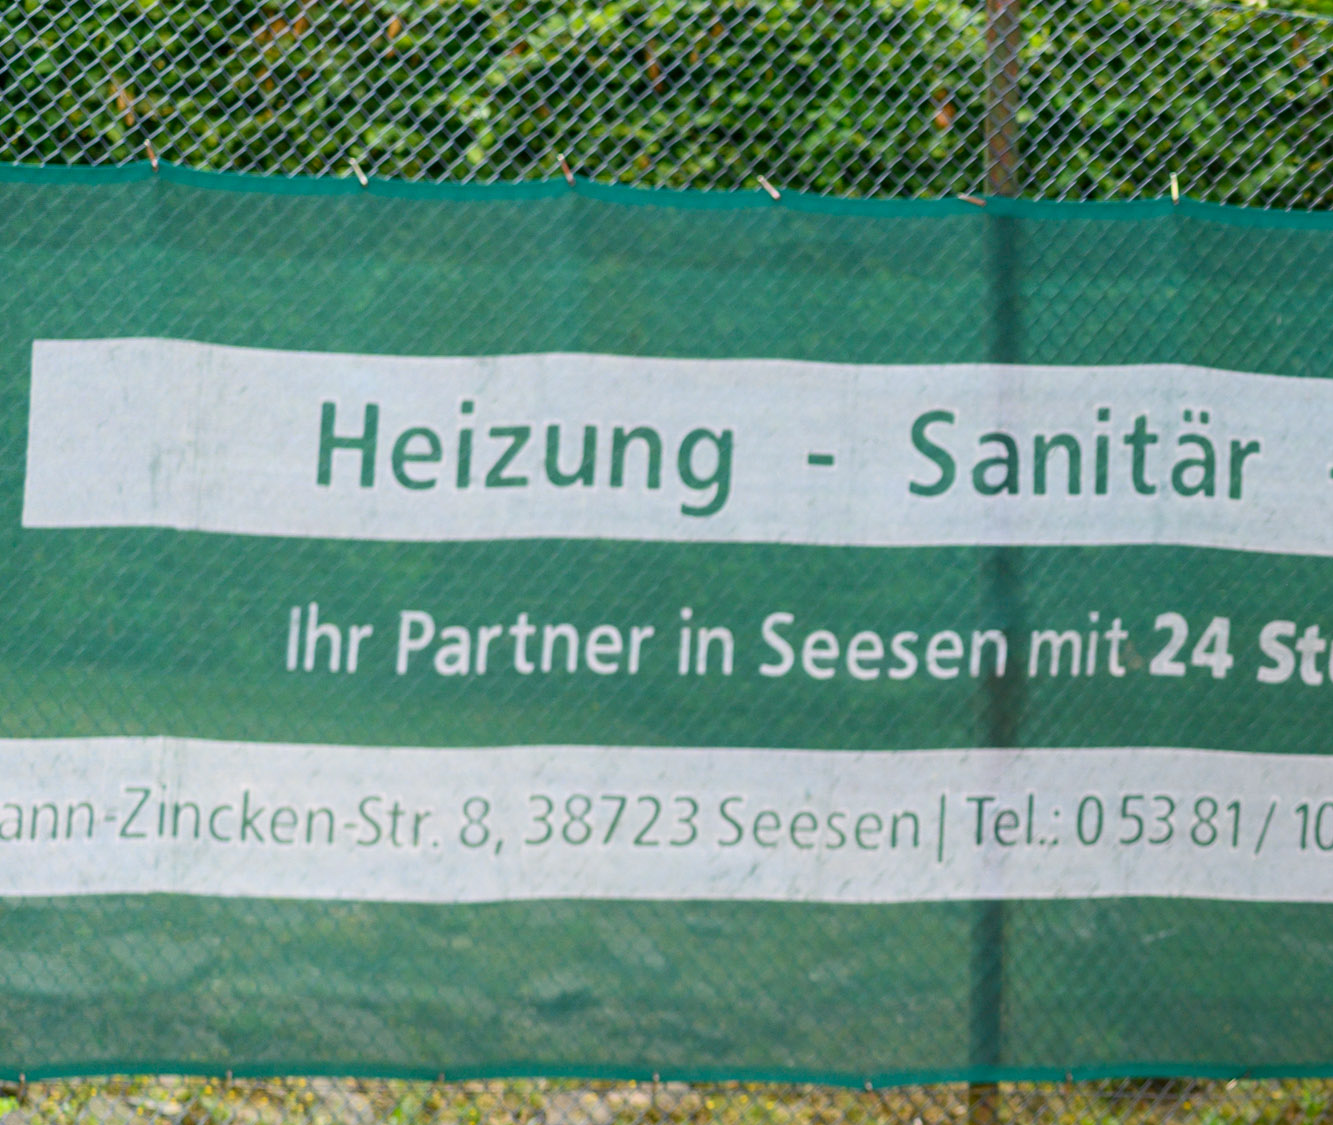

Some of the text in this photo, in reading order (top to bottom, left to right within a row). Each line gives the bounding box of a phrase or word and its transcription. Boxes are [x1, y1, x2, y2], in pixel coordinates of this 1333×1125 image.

[316, 401, 734, 518] Heizung
[908, 408, 1261, 500] Sanitär
[286, 602, 374, 674] Ihr
[396, 610, 655, 676] Partner
[678, 607, 734, 676] in
[758, 612, 1007, 680] Seesen
[1027, 610, 1129, 678] mit
[1148, 612, 1234, 679] 24
[0, 785, 439, 848] ann-Zincken-Str.
[458, 796, 504, 856] 8,
[524, 794, 700, 848] 38723
[718, 796, 920, 850] Seesen
[966, 793, 1059, 847] Tel.:
